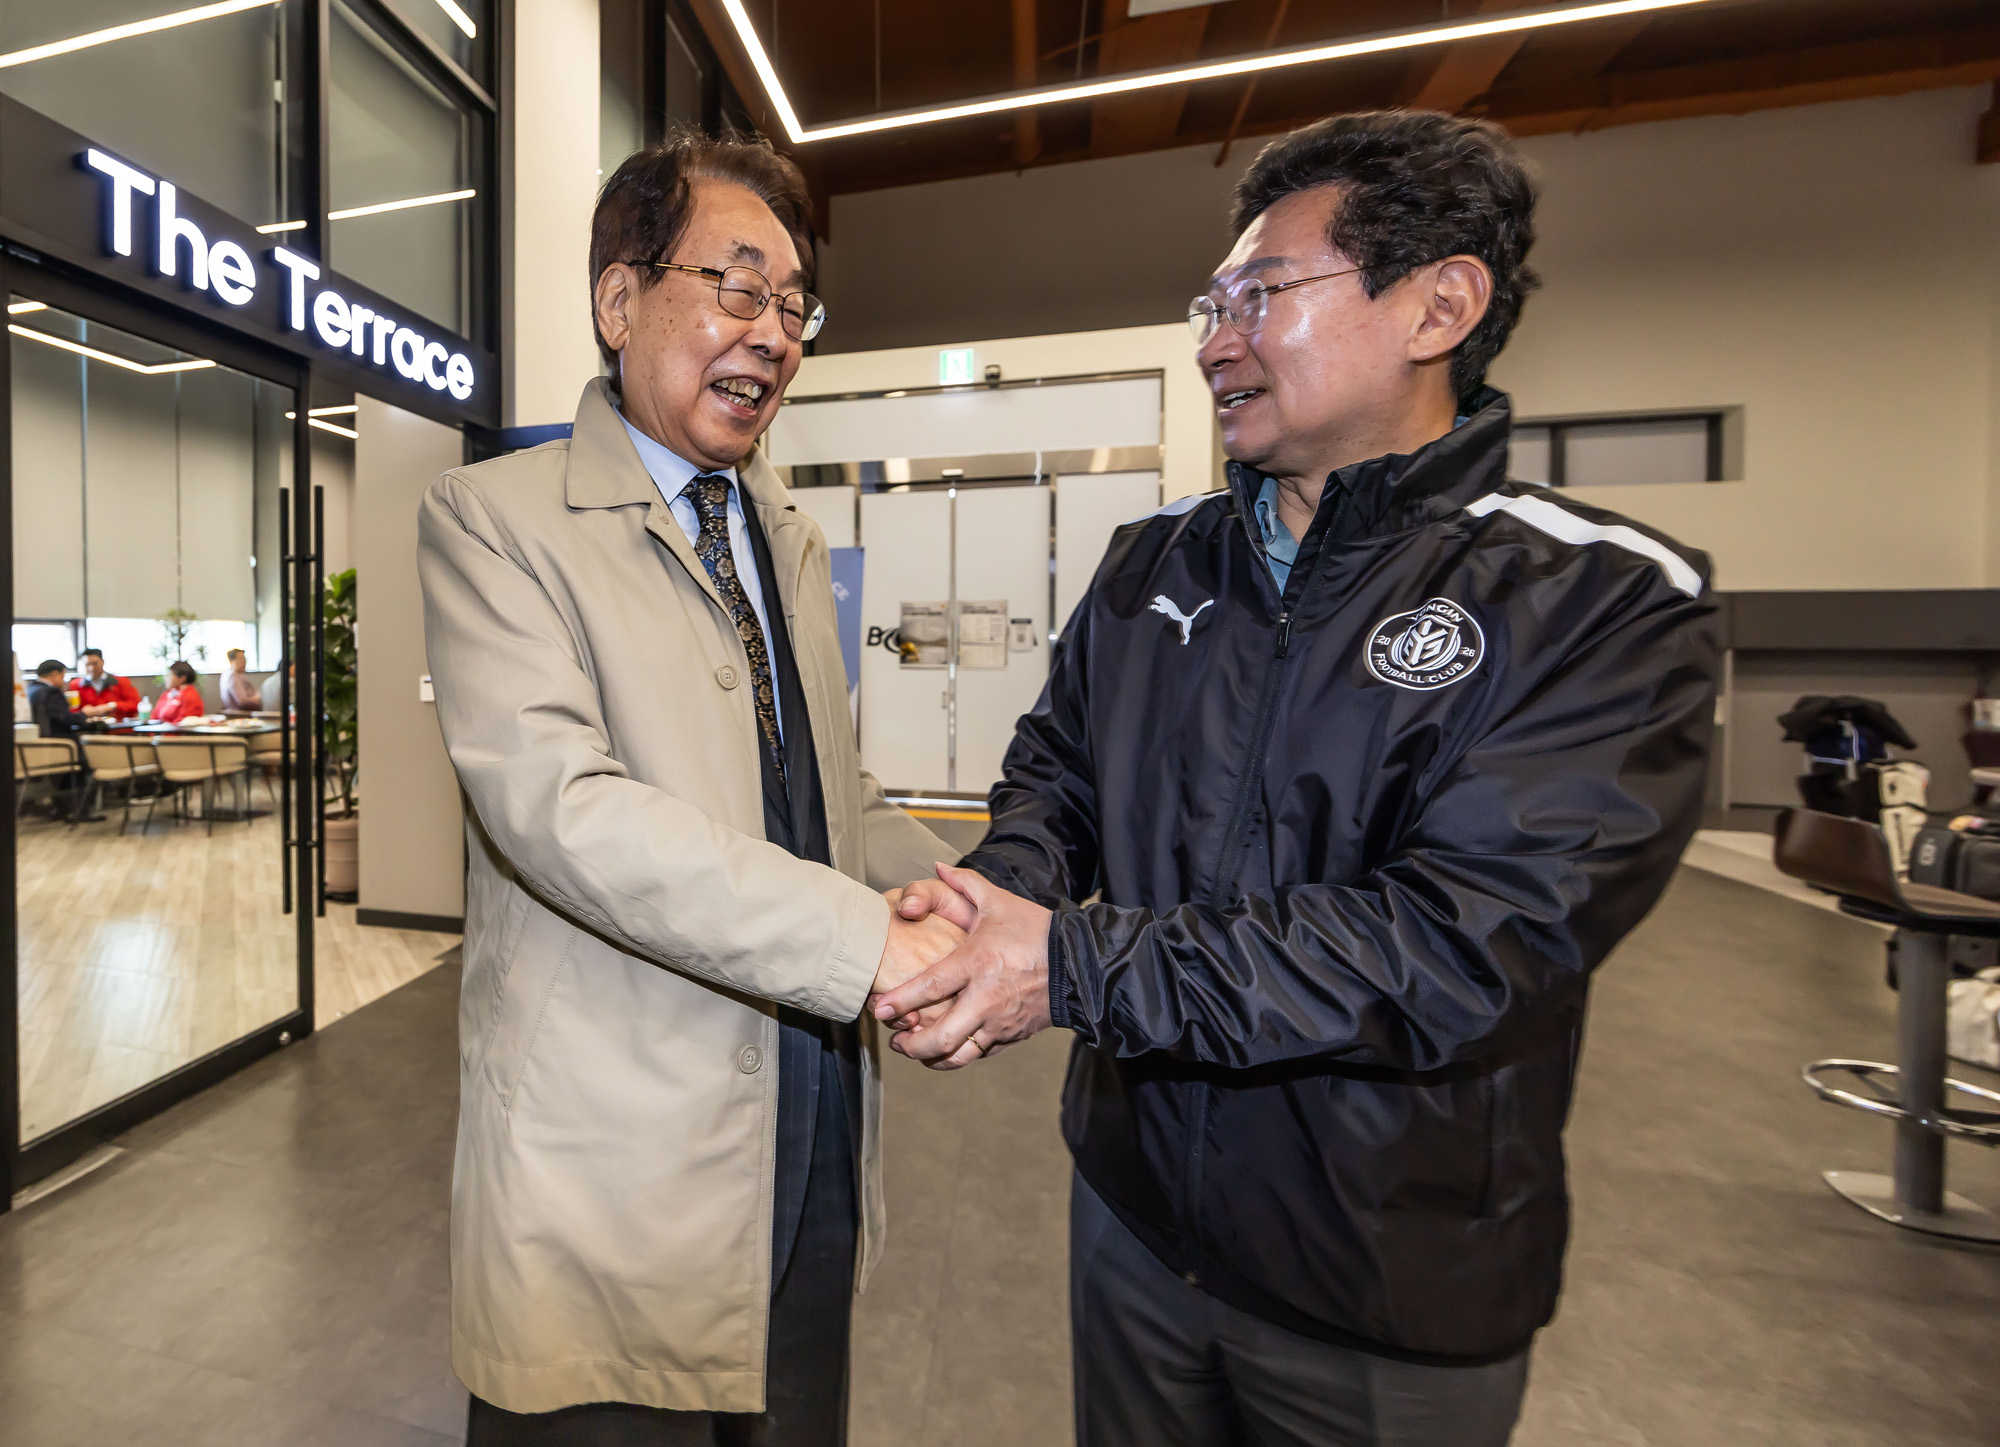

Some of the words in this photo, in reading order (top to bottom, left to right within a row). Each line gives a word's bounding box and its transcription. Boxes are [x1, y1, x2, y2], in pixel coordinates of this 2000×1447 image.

[86, 147, 257, 306] The
[273, 245, 476, 401] Terrace
[1376, 635, 1392, 646] 20
[1461, 647, 1476, 658] 26
[1373, 653, 1425, 683] FOOTBALL
[1428, 662, 1465, 683] CLUB
